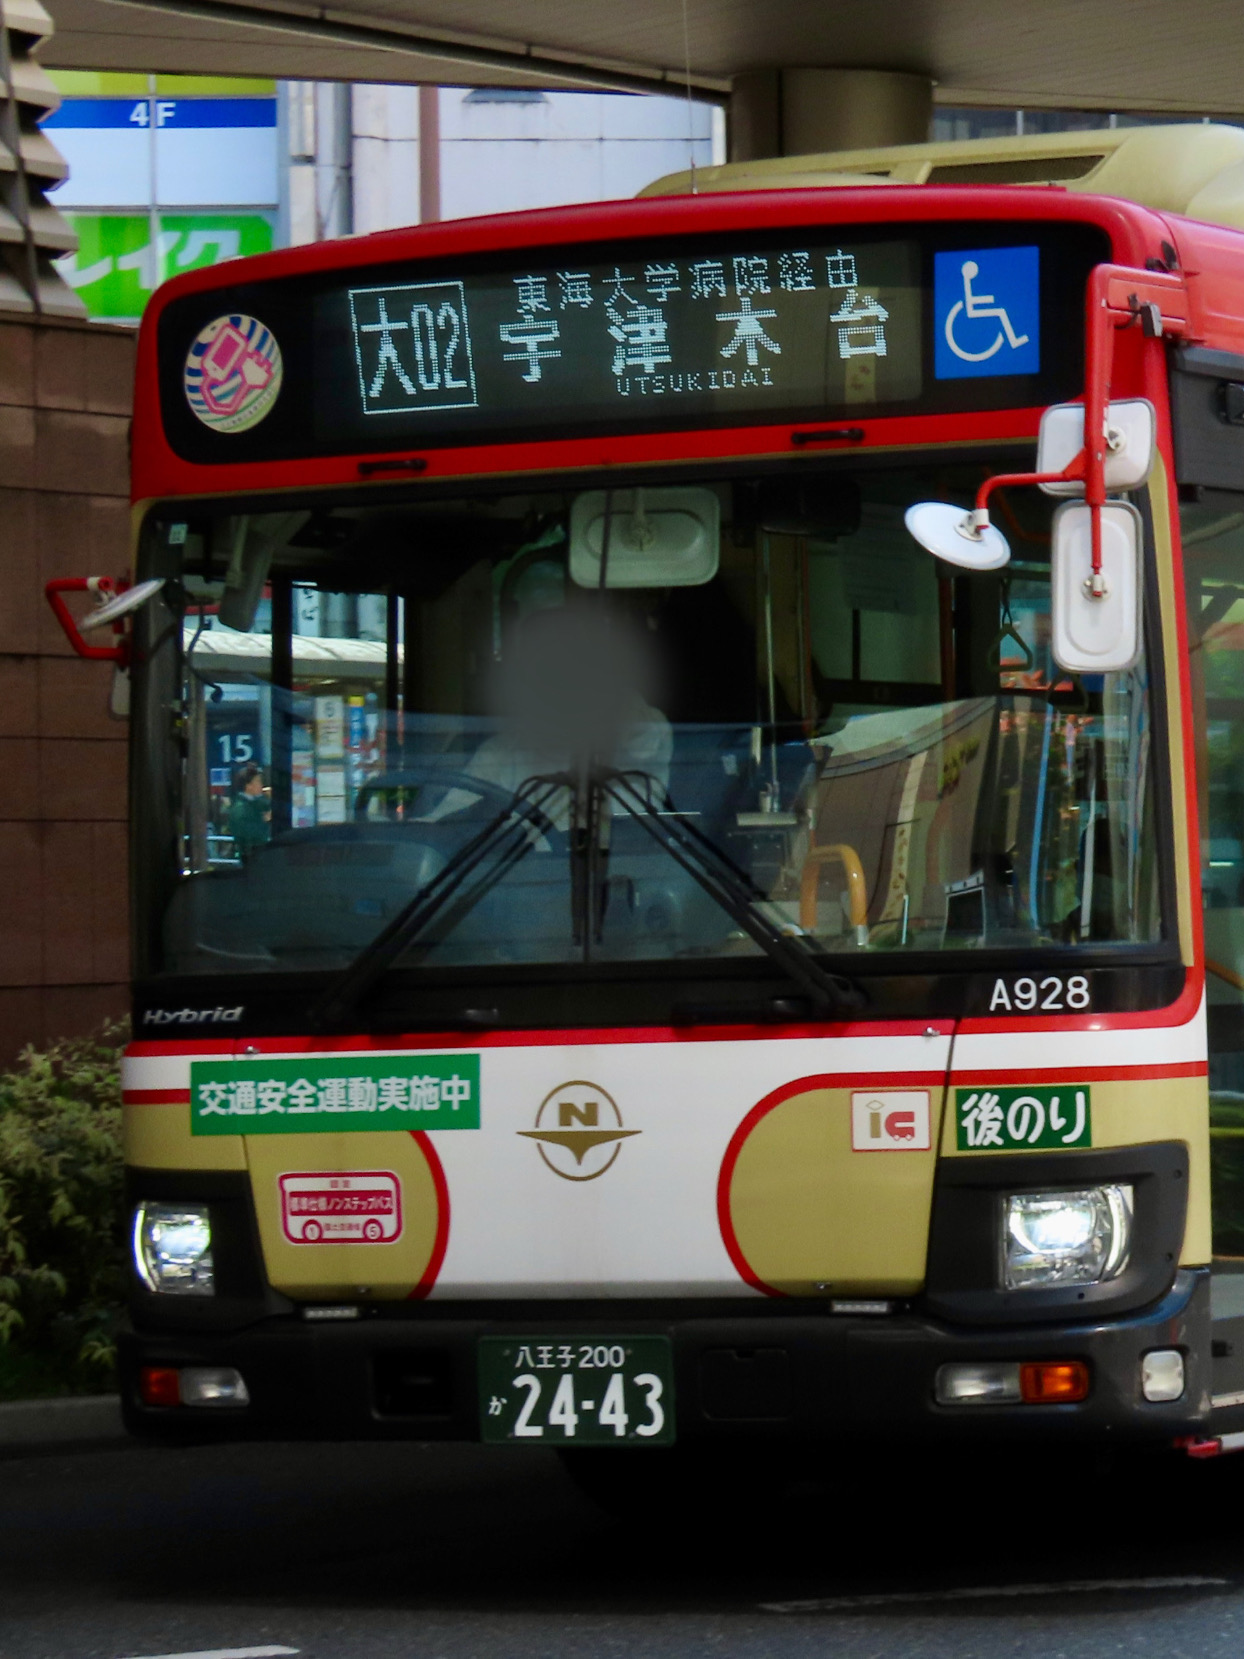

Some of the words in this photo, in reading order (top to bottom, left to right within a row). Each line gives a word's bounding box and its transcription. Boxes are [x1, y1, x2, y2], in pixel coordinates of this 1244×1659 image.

[513, 248, 859, 312] 東海大学病院経由
[499, 288, 890, 383] 宇津木台
[616, 366, 774, 396] UTSUKIDAI
[218, 734, 253, 763] 15
[989, 976, 1091, 1012] A928
[143, 1005, 244, 1025] Hybrid
[197, 1075, 472, 1116] 交通安全運動実施中
[961, 1090, 1087, 1147] 後のり
[514, 1346, 577, 1369] 八王子
[577, 1345, 625, 1369] 200
[488, 1395, 508, 1417] か
[512, 1373, 665, 1438] 24-43
